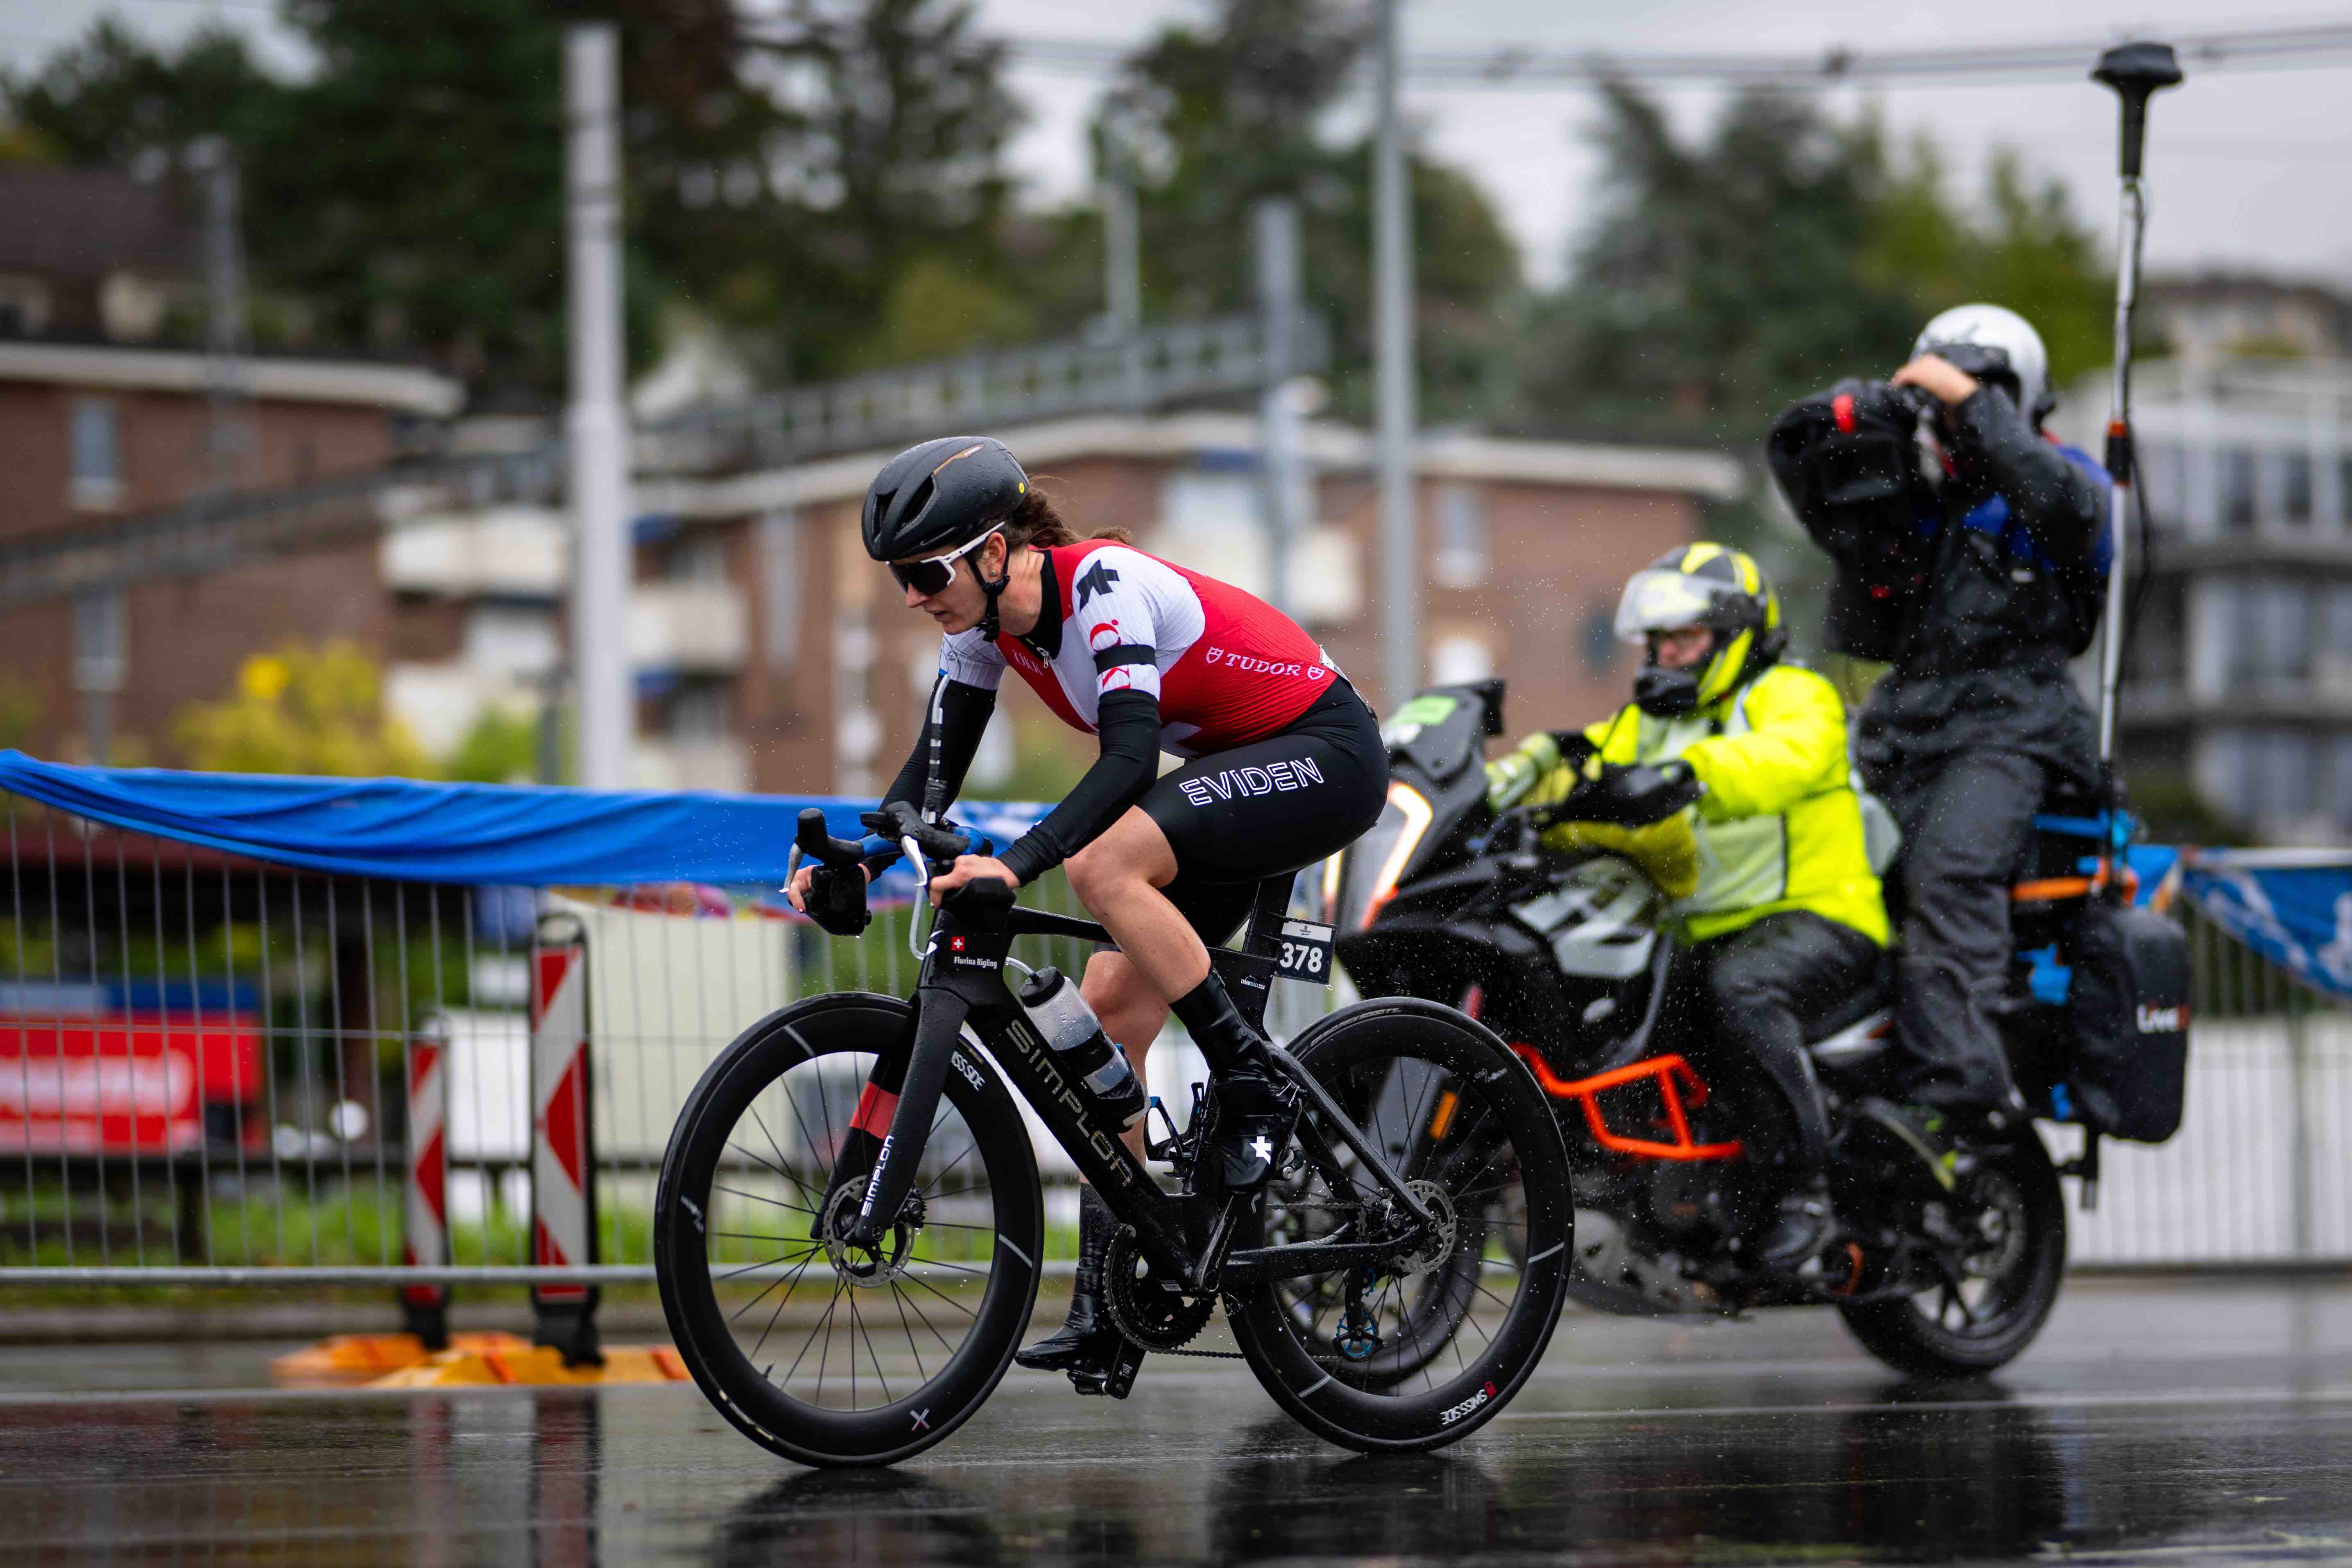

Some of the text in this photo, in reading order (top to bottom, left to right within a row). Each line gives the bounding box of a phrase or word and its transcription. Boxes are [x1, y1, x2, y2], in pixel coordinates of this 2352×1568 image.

[1225, 653, 1301, 676] TUDOR
[1179, 757, 1324, 805] EVIDEN
[954, 956, 997, 969] Flurina Rigling
[1279, 942, 1322, 973] 378
[1006, 1019, 1134, 1187] SIMPLON
[861, 1135, 894, 1217] SIMPLON
